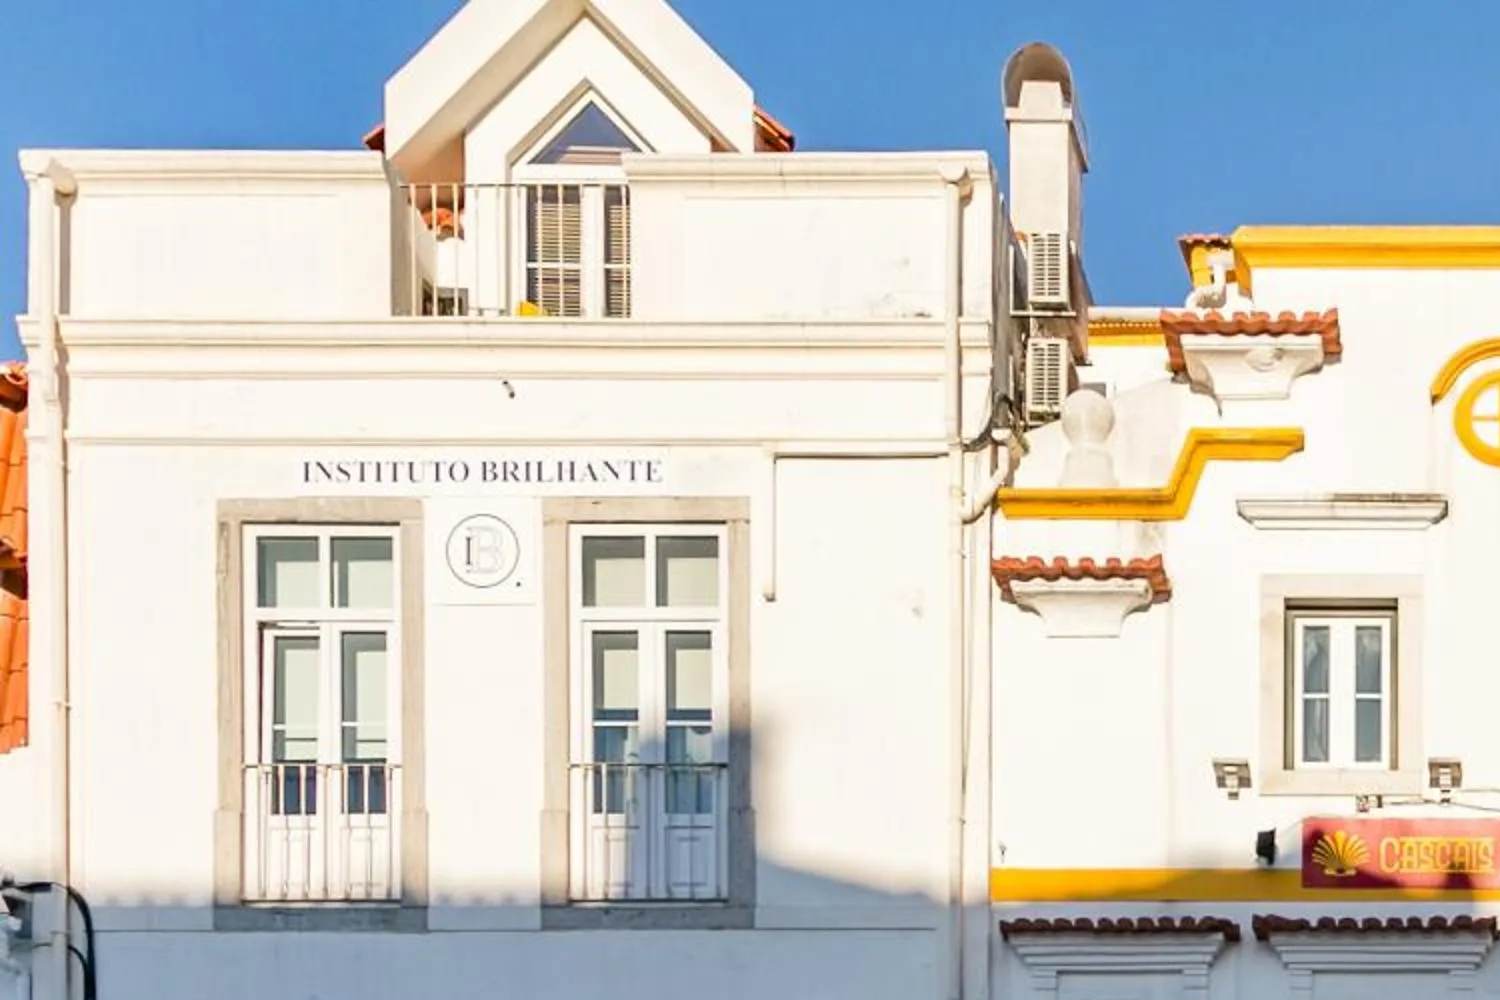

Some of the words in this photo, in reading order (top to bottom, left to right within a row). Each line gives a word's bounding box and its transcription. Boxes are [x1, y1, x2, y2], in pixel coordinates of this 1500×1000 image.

[303, 460, 470, 484] INSTITUTO
[481, 459, 663, 483] BRILHANTE
[1378, 835, 1495, 874] CASCAIS
